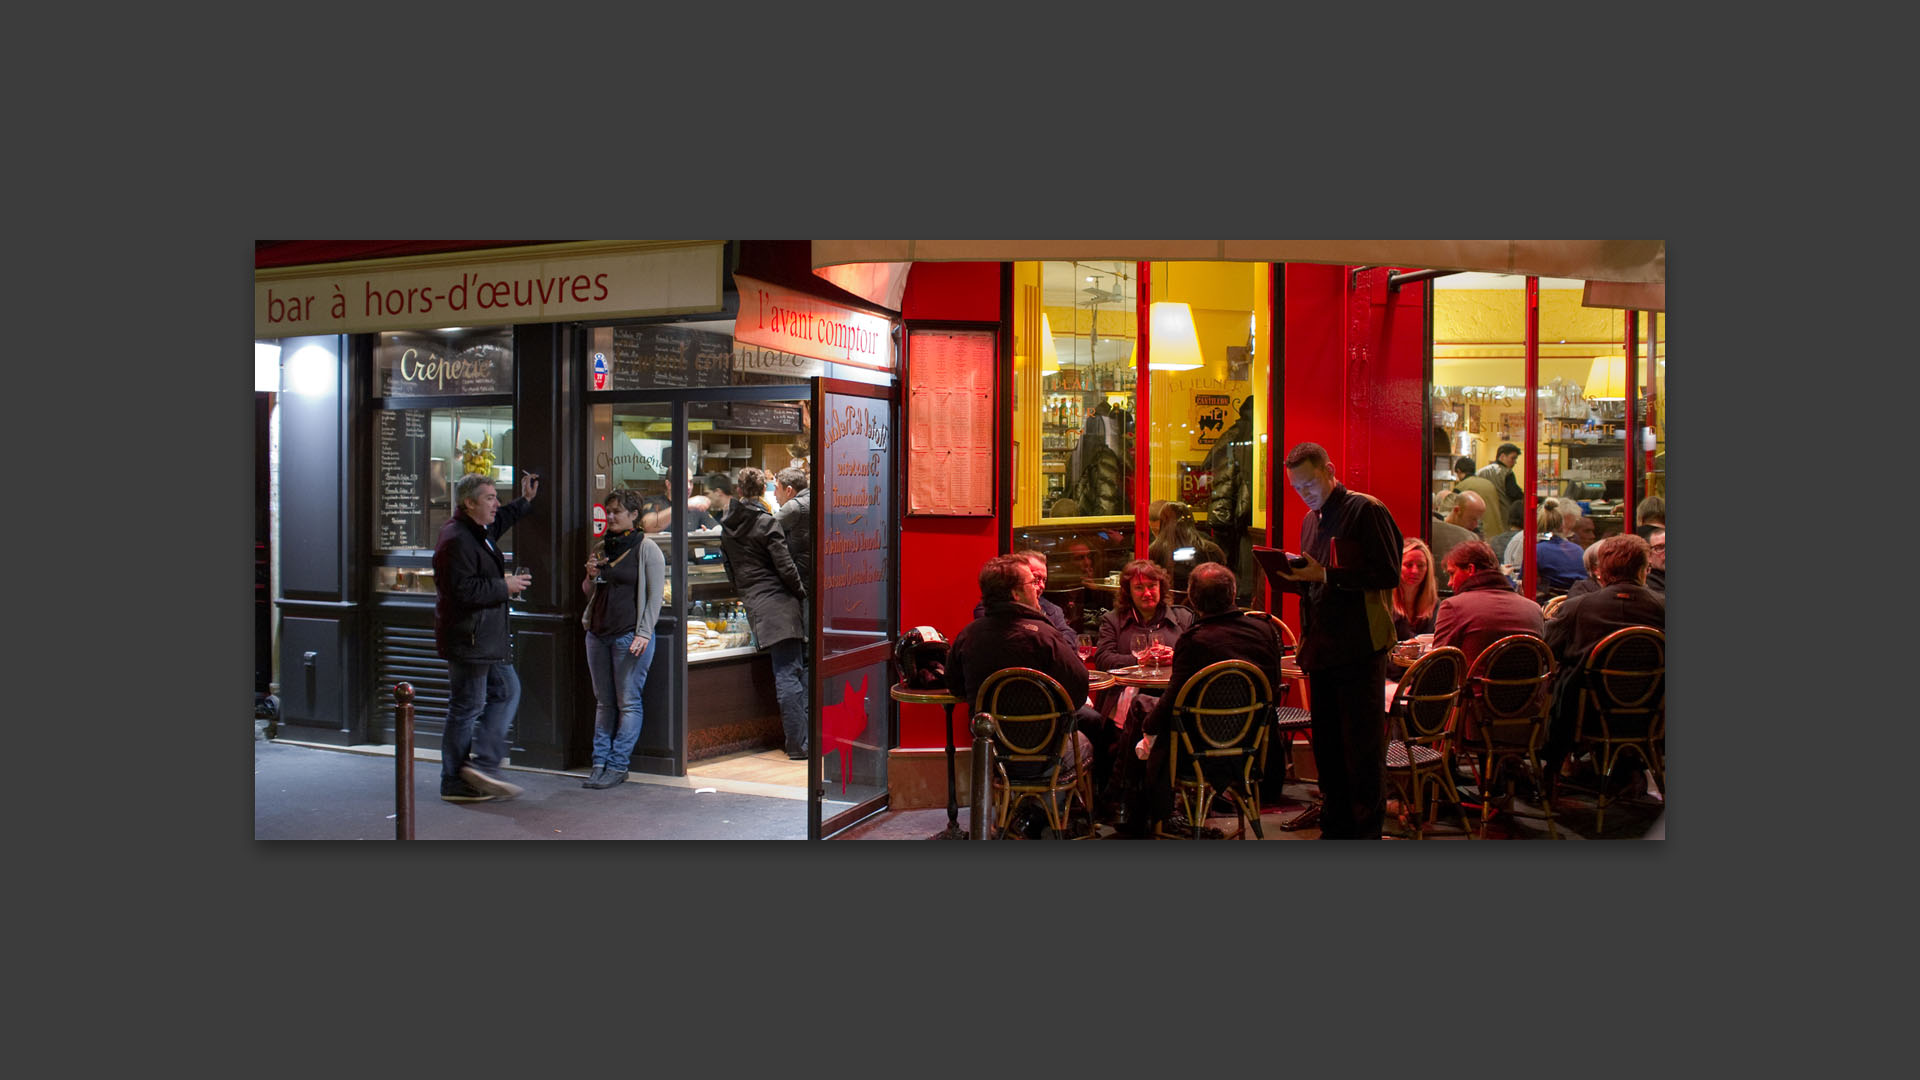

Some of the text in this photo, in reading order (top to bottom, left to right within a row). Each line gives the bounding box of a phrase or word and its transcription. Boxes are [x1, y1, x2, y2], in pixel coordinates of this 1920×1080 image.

[268, 288, 315, 324] bar
[331, 284, 346, 319] à
[758, 288, 813, 341] l'avant
[817, 317, 879, 361] comptoir
[400, 348, 491, 392] Crêperie
